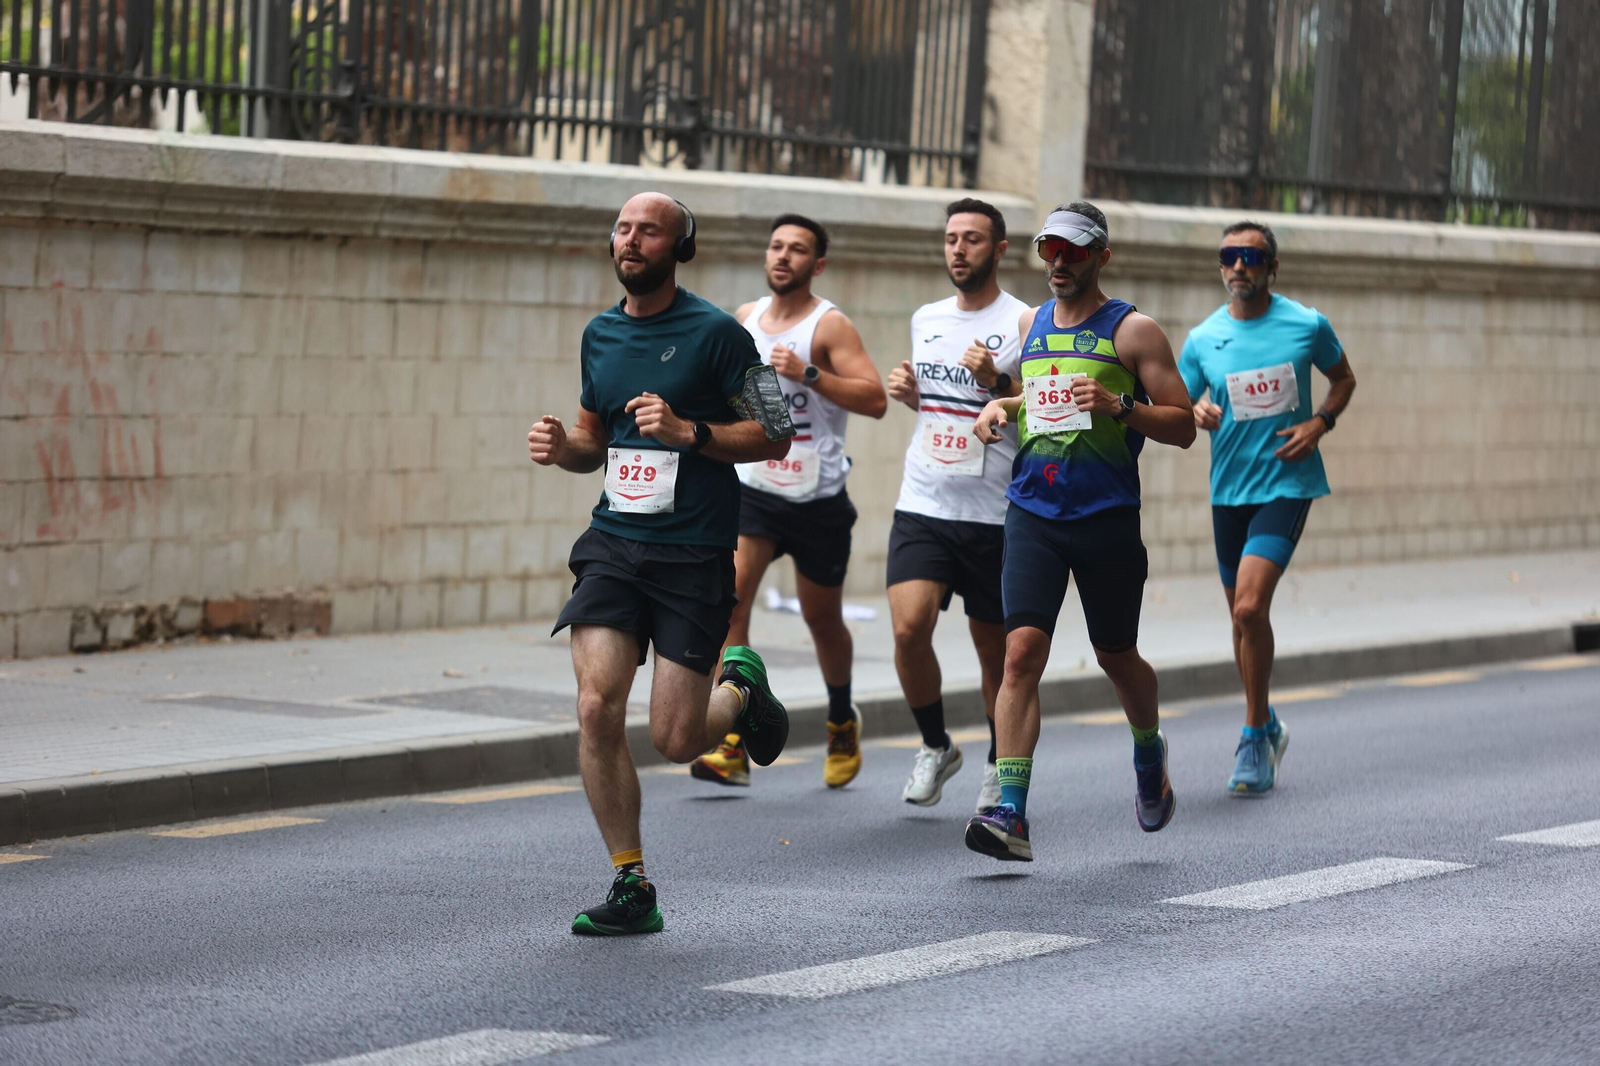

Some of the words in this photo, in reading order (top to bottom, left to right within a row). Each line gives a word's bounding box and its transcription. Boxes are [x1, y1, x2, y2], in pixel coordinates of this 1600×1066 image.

[1245, 378, 1280, 396] 407
[1038, 389, 1072, 406] 363
[933, 433, 967, 449] 578
[619, 464, 657, 482] 979
[766, 459, 803, 473] 696
